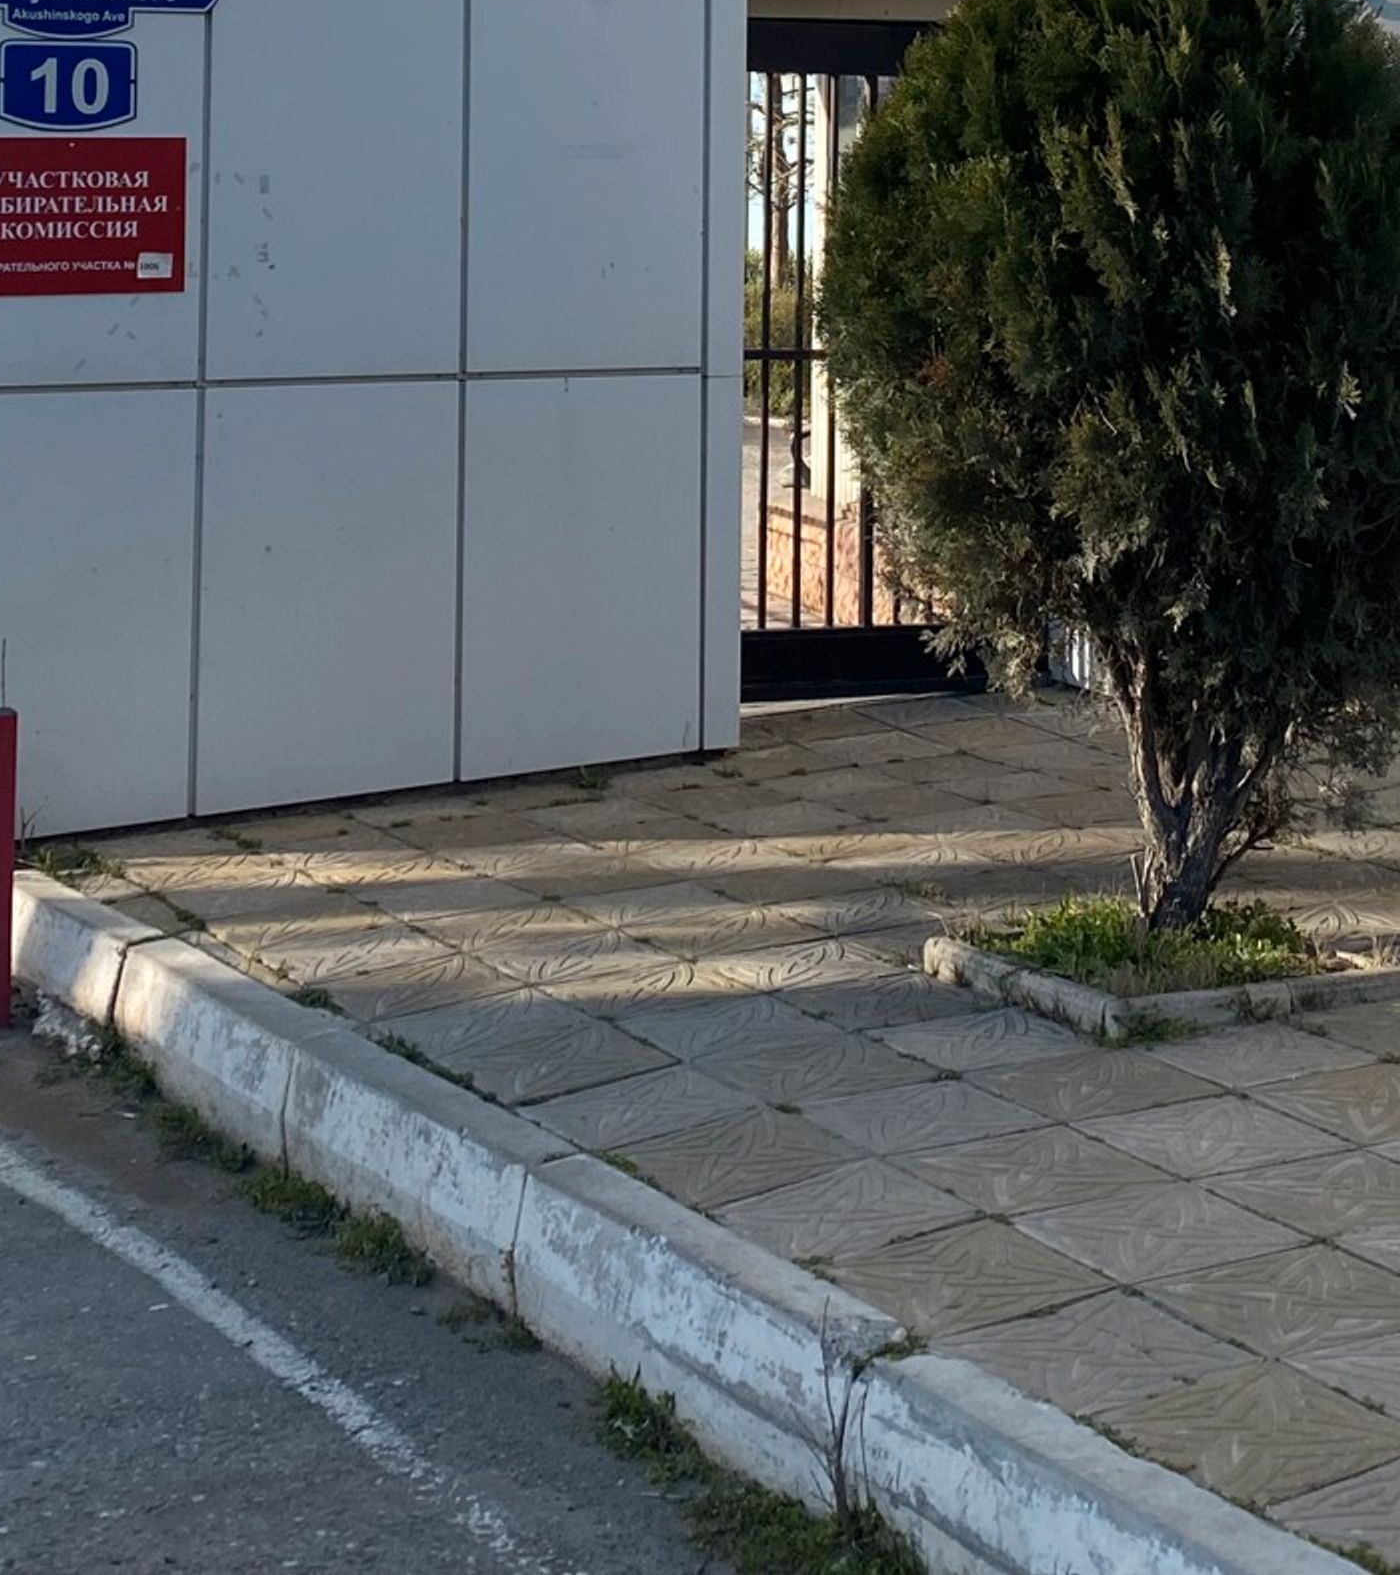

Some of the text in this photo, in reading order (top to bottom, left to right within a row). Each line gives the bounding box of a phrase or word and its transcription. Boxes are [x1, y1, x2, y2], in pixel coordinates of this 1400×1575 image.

[12, 7, 126, 24] Akushinskogo Ave
[30, 56, 110, 115] 10
[0, 220, 139, 241] КОМИССИЯ
[71, 260, 123, 272] УЧАСТКА
